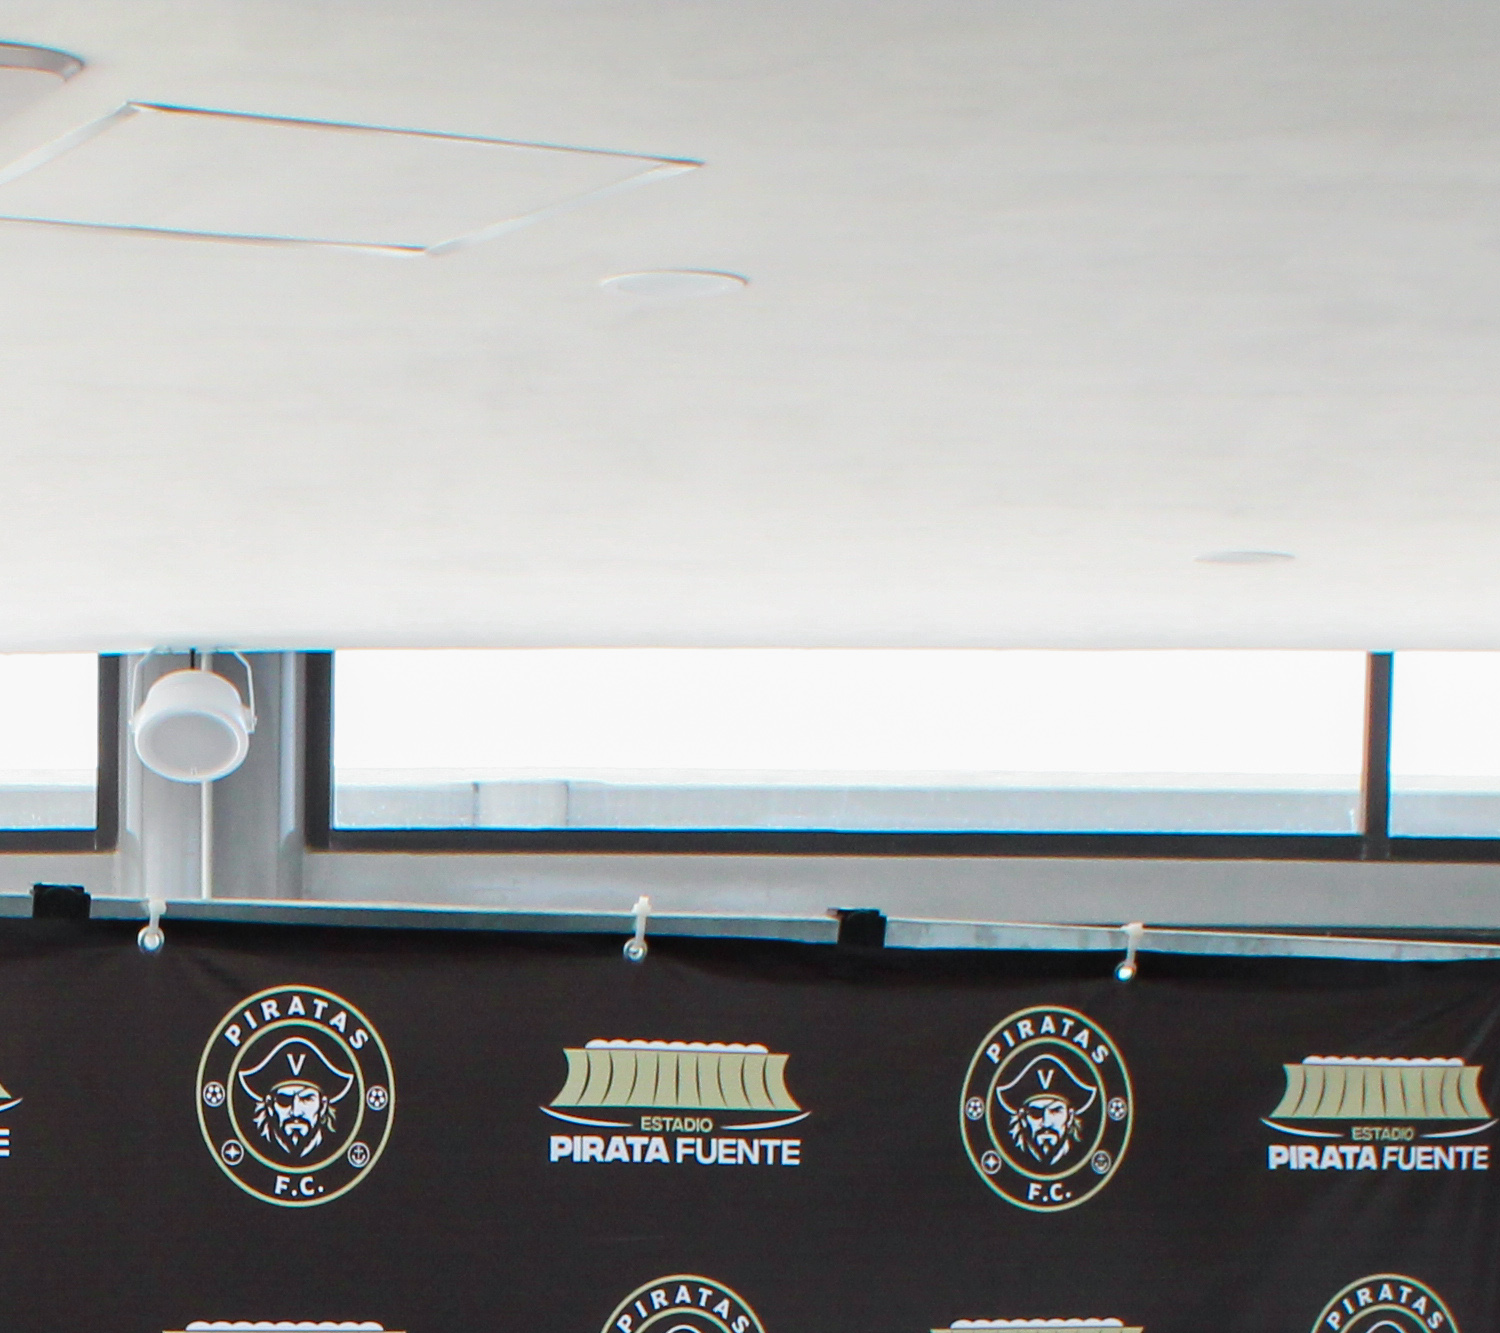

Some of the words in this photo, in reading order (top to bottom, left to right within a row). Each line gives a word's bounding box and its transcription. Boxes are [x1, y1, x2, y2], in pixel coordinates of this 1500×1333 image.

[224, 995, 369, 1049] PIRATAS
[986, 1015, 1109, 1064] PIRATAS
[640, 1116, 713, 1133] ESTADIO
[1352, 1126, 1414, 1141] ESTADIO
[550, 1135, 670, 1163] PIRATA
[676, 1137, 801, 1165] FUENTE
[1268, 1144, 1378, 1170] PIRATA
[1382, 1145, 1489, 1170] FUENTE
[274, 1175, 324, 1197] F.C.
[1028, 1182, 1072, 1202] F.C.
[1326, 1283, 1444, 1331] PIRATAS
